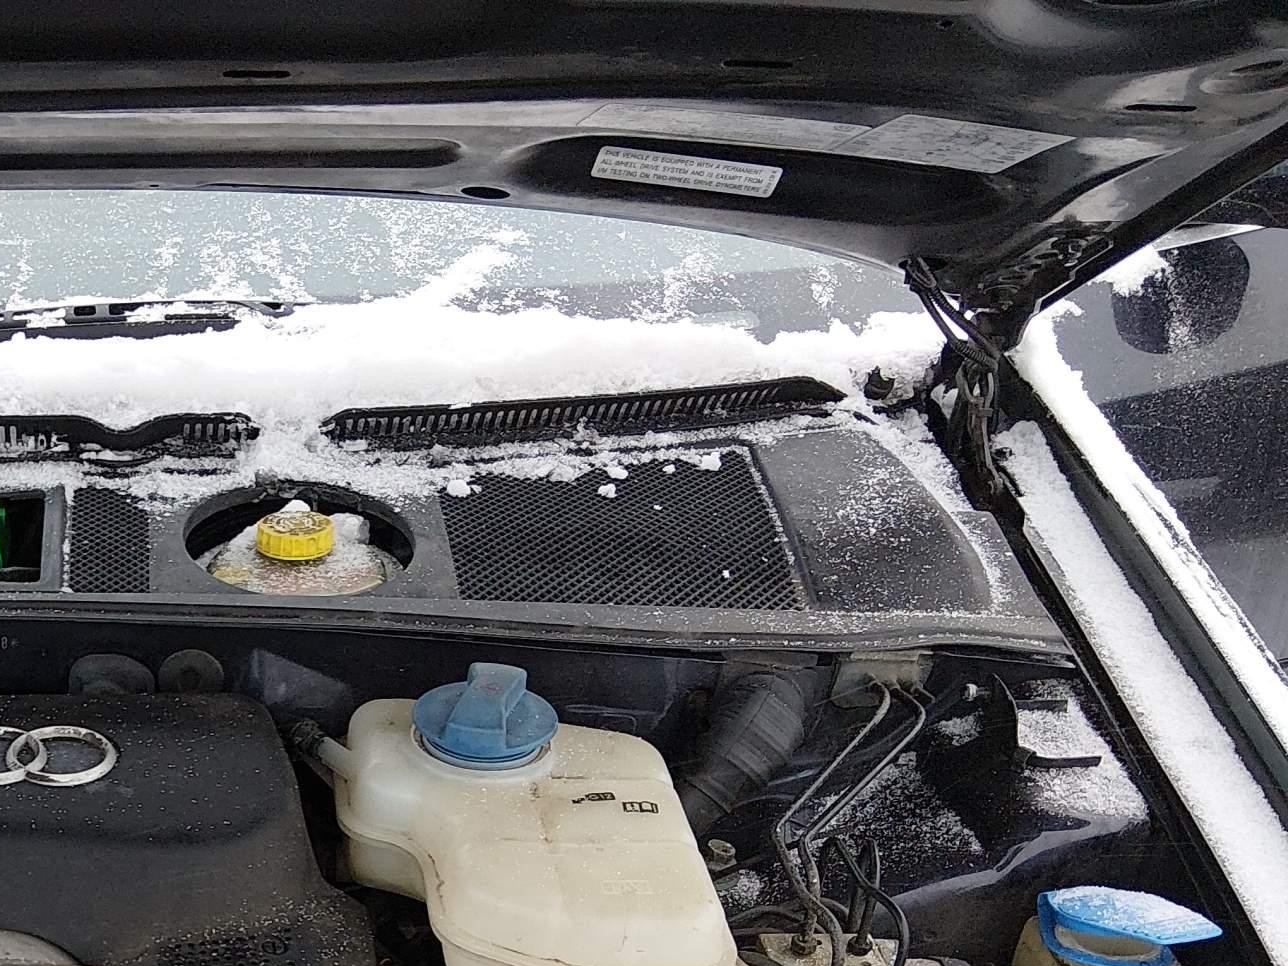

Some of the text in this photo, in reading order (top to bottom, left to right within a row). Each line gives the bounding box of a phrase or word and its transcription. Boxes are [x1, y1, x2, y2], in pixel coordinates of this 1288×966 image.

[610, 168, 638, 177] TESTING
[622, 152, 650, 161] VEHICLE
[661, 156, 695, 166] EQUIPPED
[722, 165, 763, 175] PERMANENT
[640, 163, 660, 171] DRIVE
[662, 166, 688, 175] SYSTEM
[715, 173, 743, 181] EXEMPT
[744, 176, 764, 184] FROM
